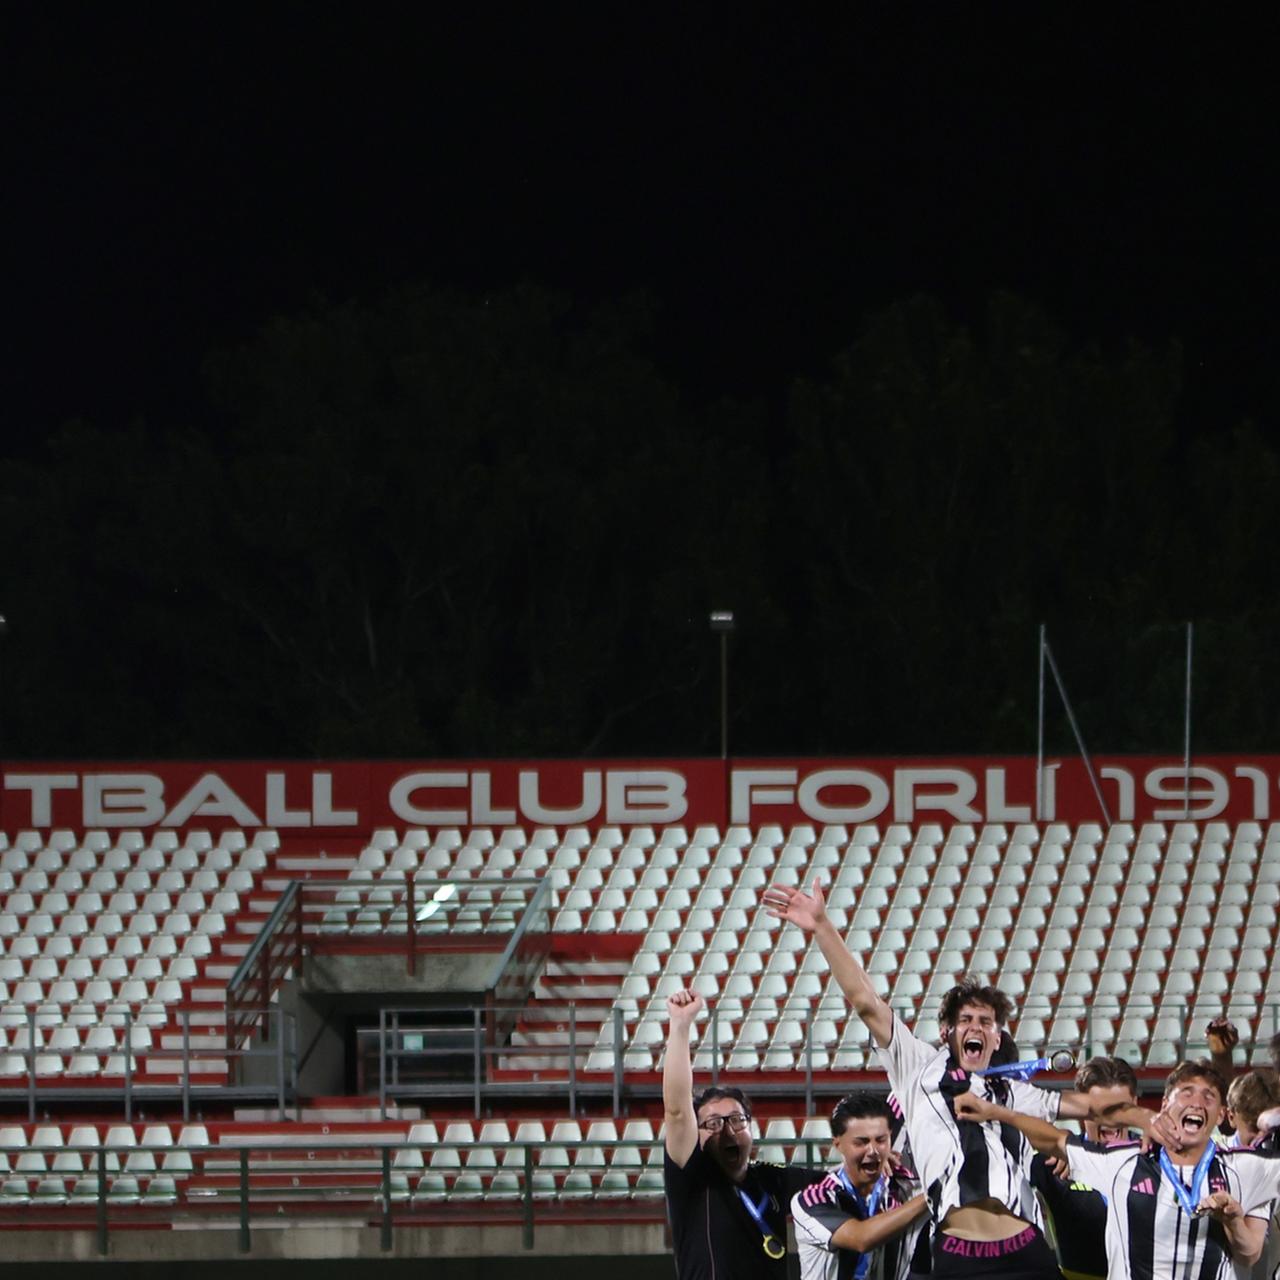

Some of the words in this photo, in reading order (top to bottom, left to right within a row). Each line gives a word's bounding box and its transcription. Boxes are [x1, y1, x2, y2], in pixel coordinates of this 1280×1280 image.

[4, 773, 358, 827] TBALL
[389, 771, 689, 825] CLUB
[943, 1236, 1001, 1257] CALVIN
[1003, 1225, 1036, 1254] KLEIN
